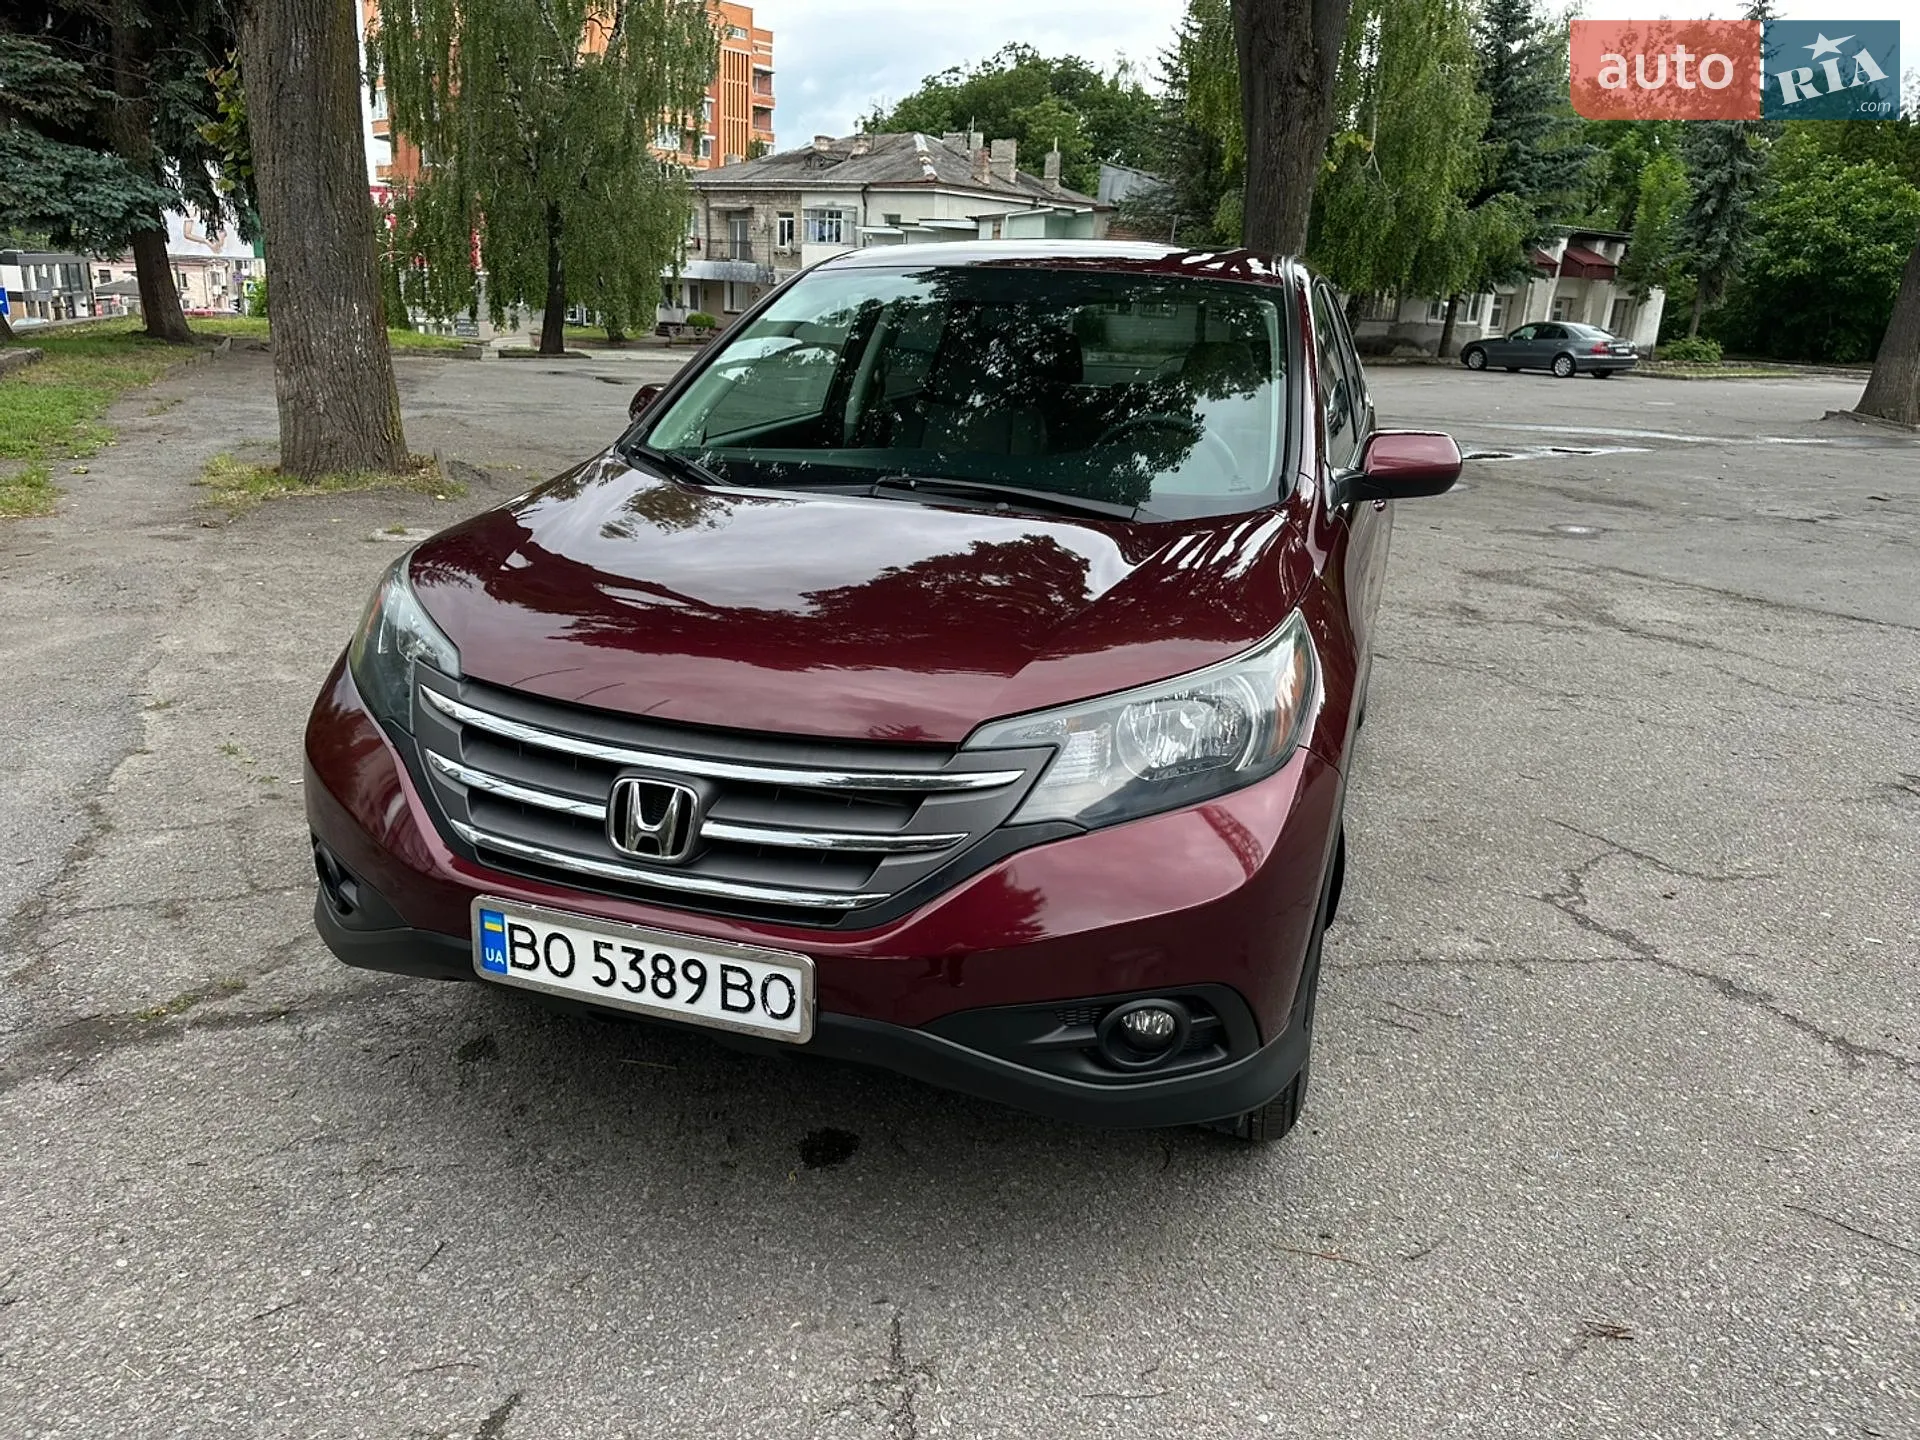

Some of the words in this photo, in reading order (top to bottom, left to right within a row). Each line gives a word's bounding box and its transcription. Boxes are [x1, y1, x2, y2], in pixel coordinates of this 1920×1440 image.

[485, 947, 505, 965] UA
[507, 922, 576, 978] BO
[591, 939, 708, 1005] 5389
[719, 963, 797, 1020] BO
